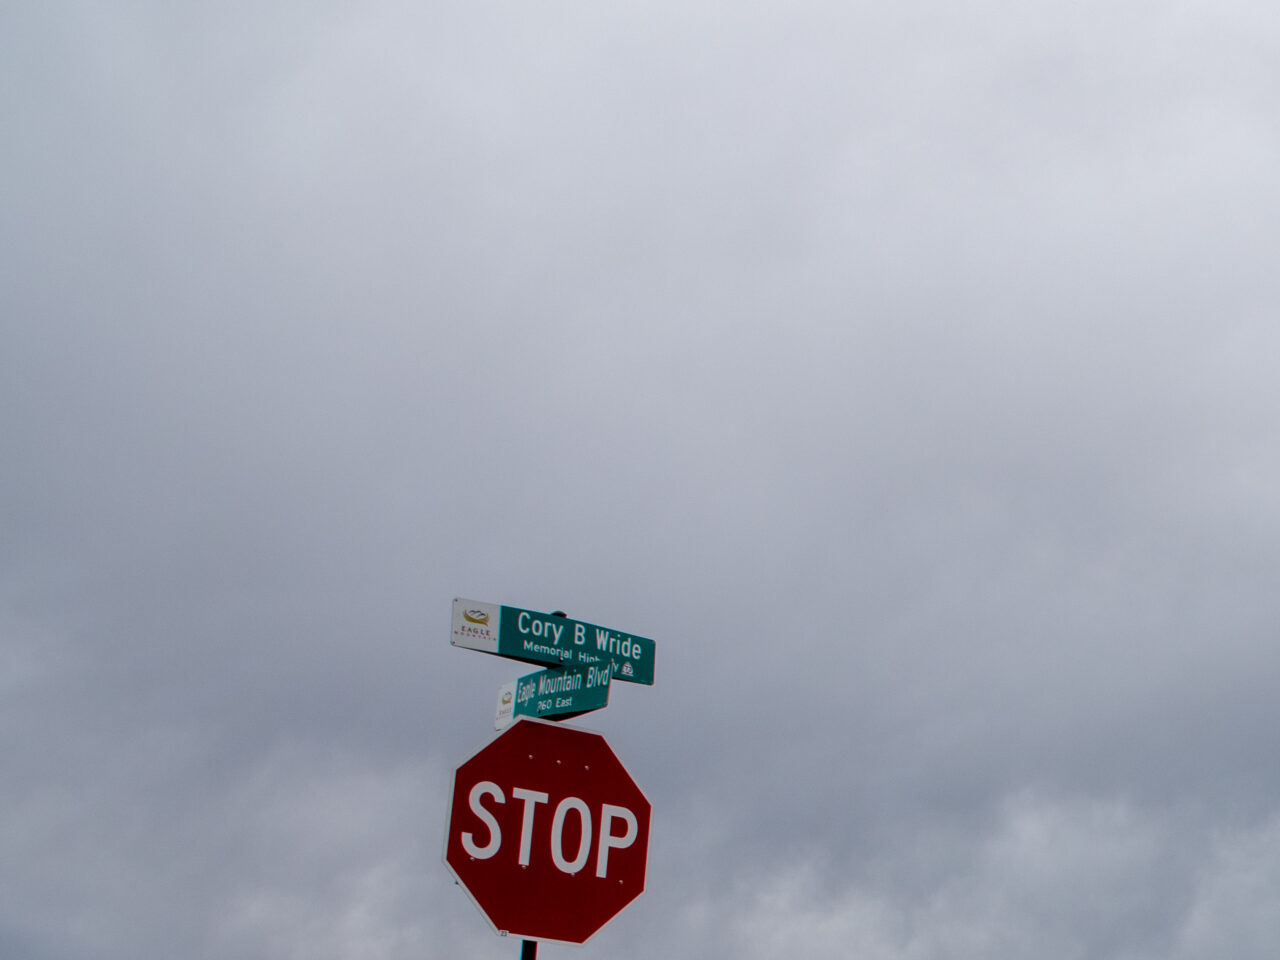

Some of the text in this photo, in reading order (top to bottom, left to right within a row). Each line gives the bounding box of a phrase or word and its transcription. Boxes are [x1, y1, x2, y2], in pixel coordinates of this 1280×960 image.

[461, 625, 490, 636] EAGLE
[517, 611, 642, 660] Cory B Wride
[523, 639, 573, 660] Memorial
[517, 663, 611, 708] Eagle Mountain Blvd
[555, 696, 573, 708] East
[461, 780, 638, 879] STOP
